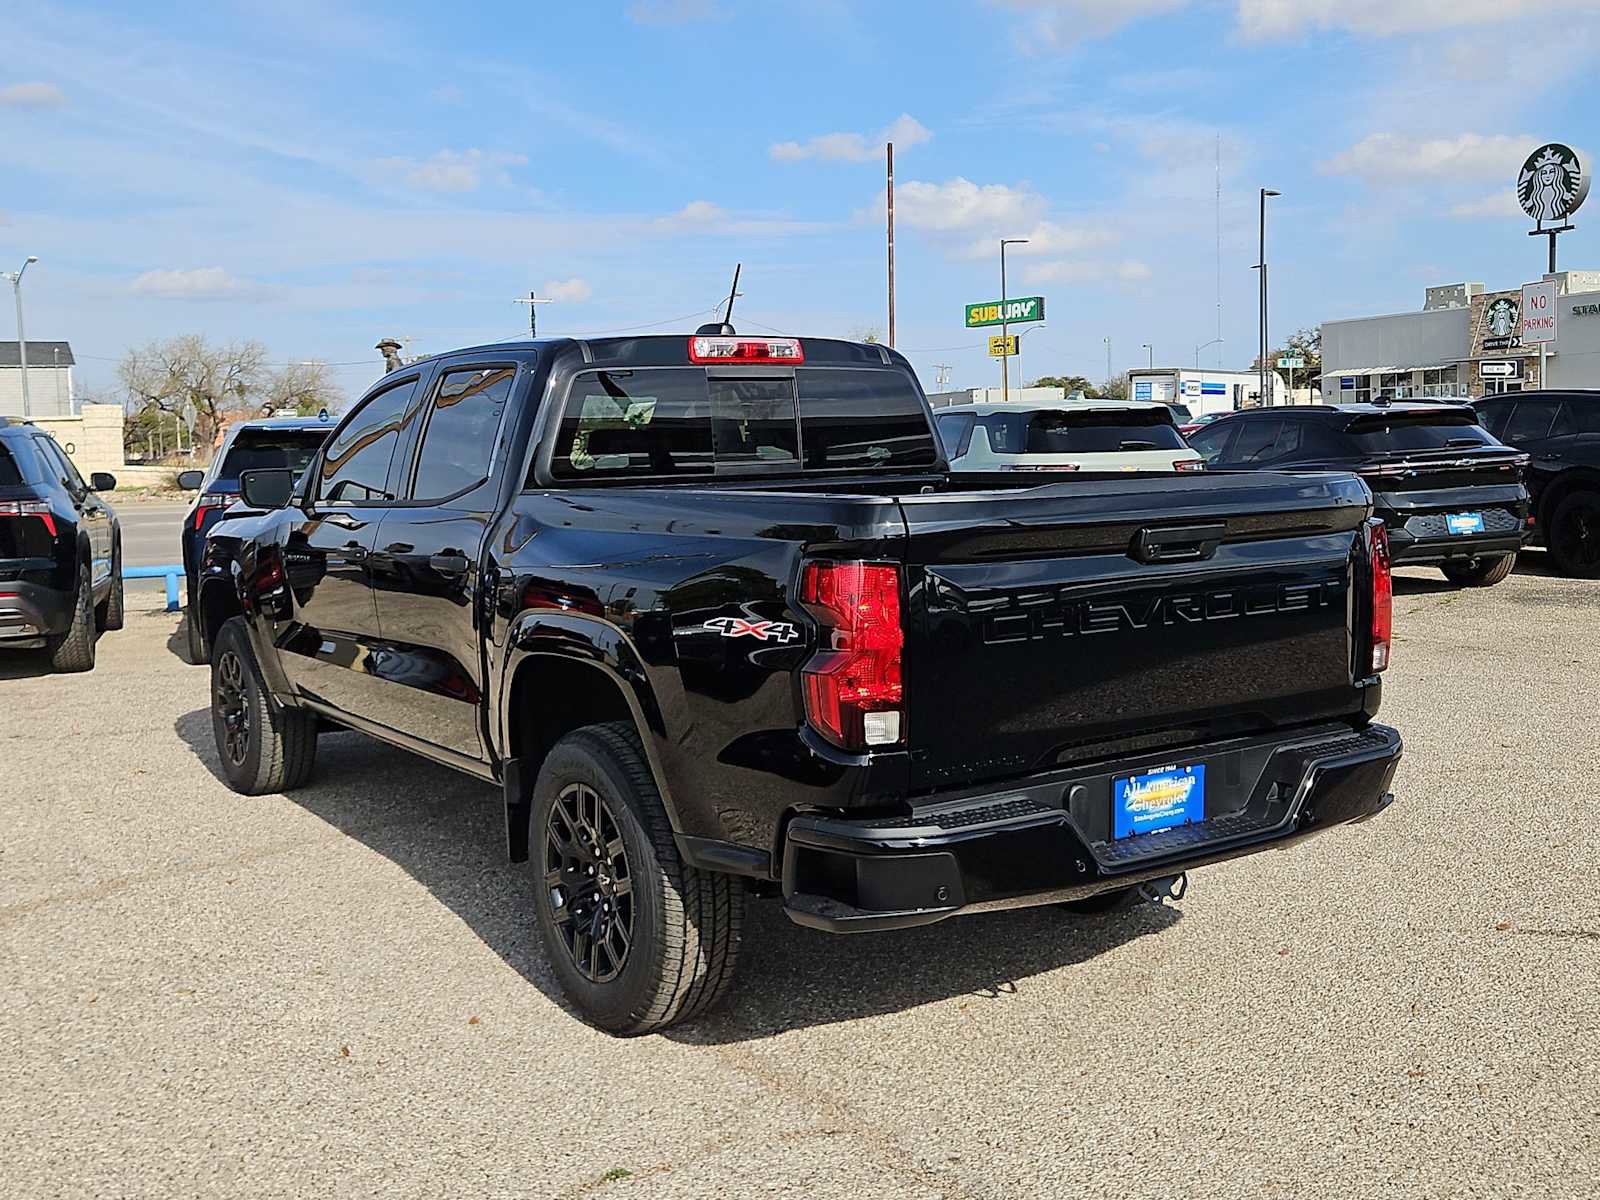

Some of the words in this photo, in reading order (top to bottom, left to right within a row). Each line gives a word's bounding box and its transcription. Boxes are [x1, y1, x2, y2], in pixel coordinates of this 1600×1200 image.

[968, 301, 1035, 323] SUBWAY
[1531, 296, 1546, 309] NO
[1572, 304, 1600, 315] STA
[1524, 317, 1553, 330] PARKING
[983, 581, 1340, 644] CHEVROLET
[1123, 783, 1141, 797] All
[1145, 776, 1195, 792] American
[1134, 792, 1187, 811] Chevrolet
